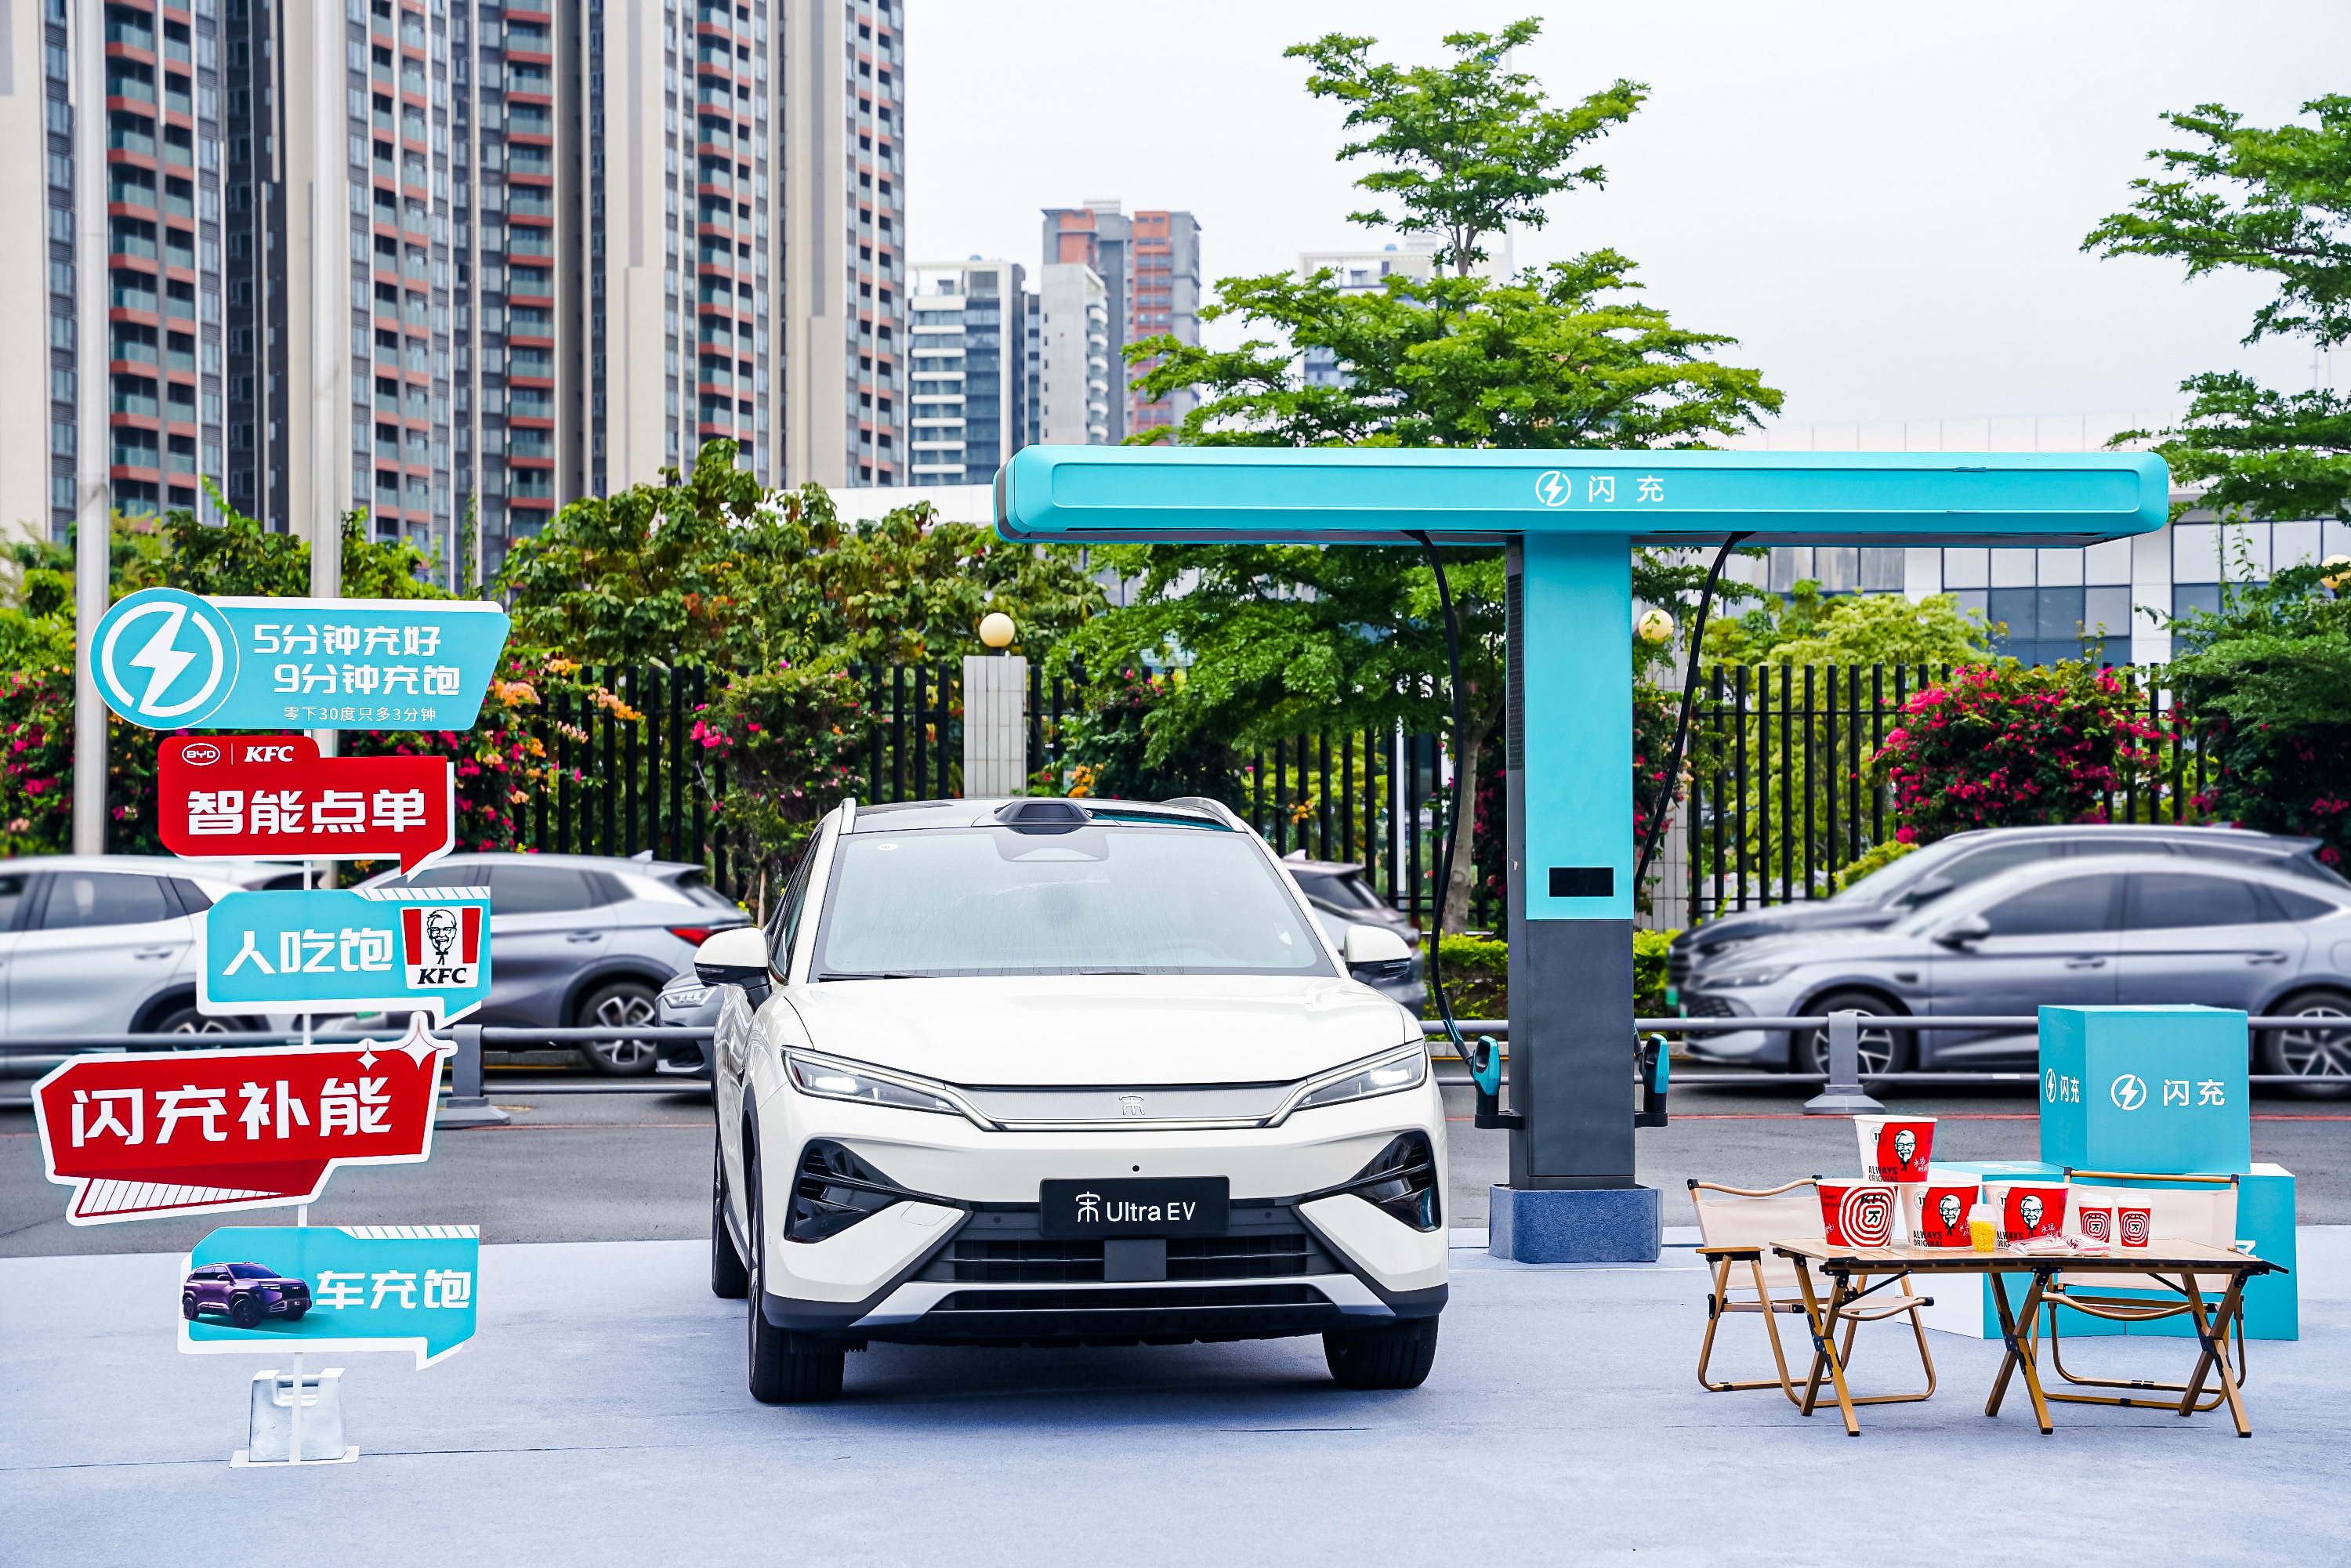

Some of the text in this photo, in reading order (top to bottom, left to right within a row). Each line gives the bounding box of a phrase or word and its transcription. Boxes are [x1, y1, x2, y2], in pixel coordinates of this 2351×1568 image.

[1588, 475, 1665, 503] 闪充
[254, 624, 441, 657] 5分钟充好
[273, 663, 460, 696] 9分钟充饱
[283, 706, 436, 722] 零下30度只多3分钟
[187, 745, 295, 762] BYD KFC
[187, 788, 426, 835] 智能点单
[222, 927, 393, 976] 人吃饱
[417, 967, 467, 984] KFC
[2060, 1074, 2080, 1103] 闪充
[2163, 1078, 2226, 1106] 闪充
[71, 1077, 393, 1148] 闪充补能
[1868, 1166, 1898, 1175] ALWAYS
[1107, 1201, 1161, 1222] Ultra
[1167, 1201, 1196, 1221] EV
[1913, 1230, 1943, 1240] ALWAYS
[1997, 1231, 2024, 1240] ALWAYS
[315, 1269, 471, 1310] 车充饱
